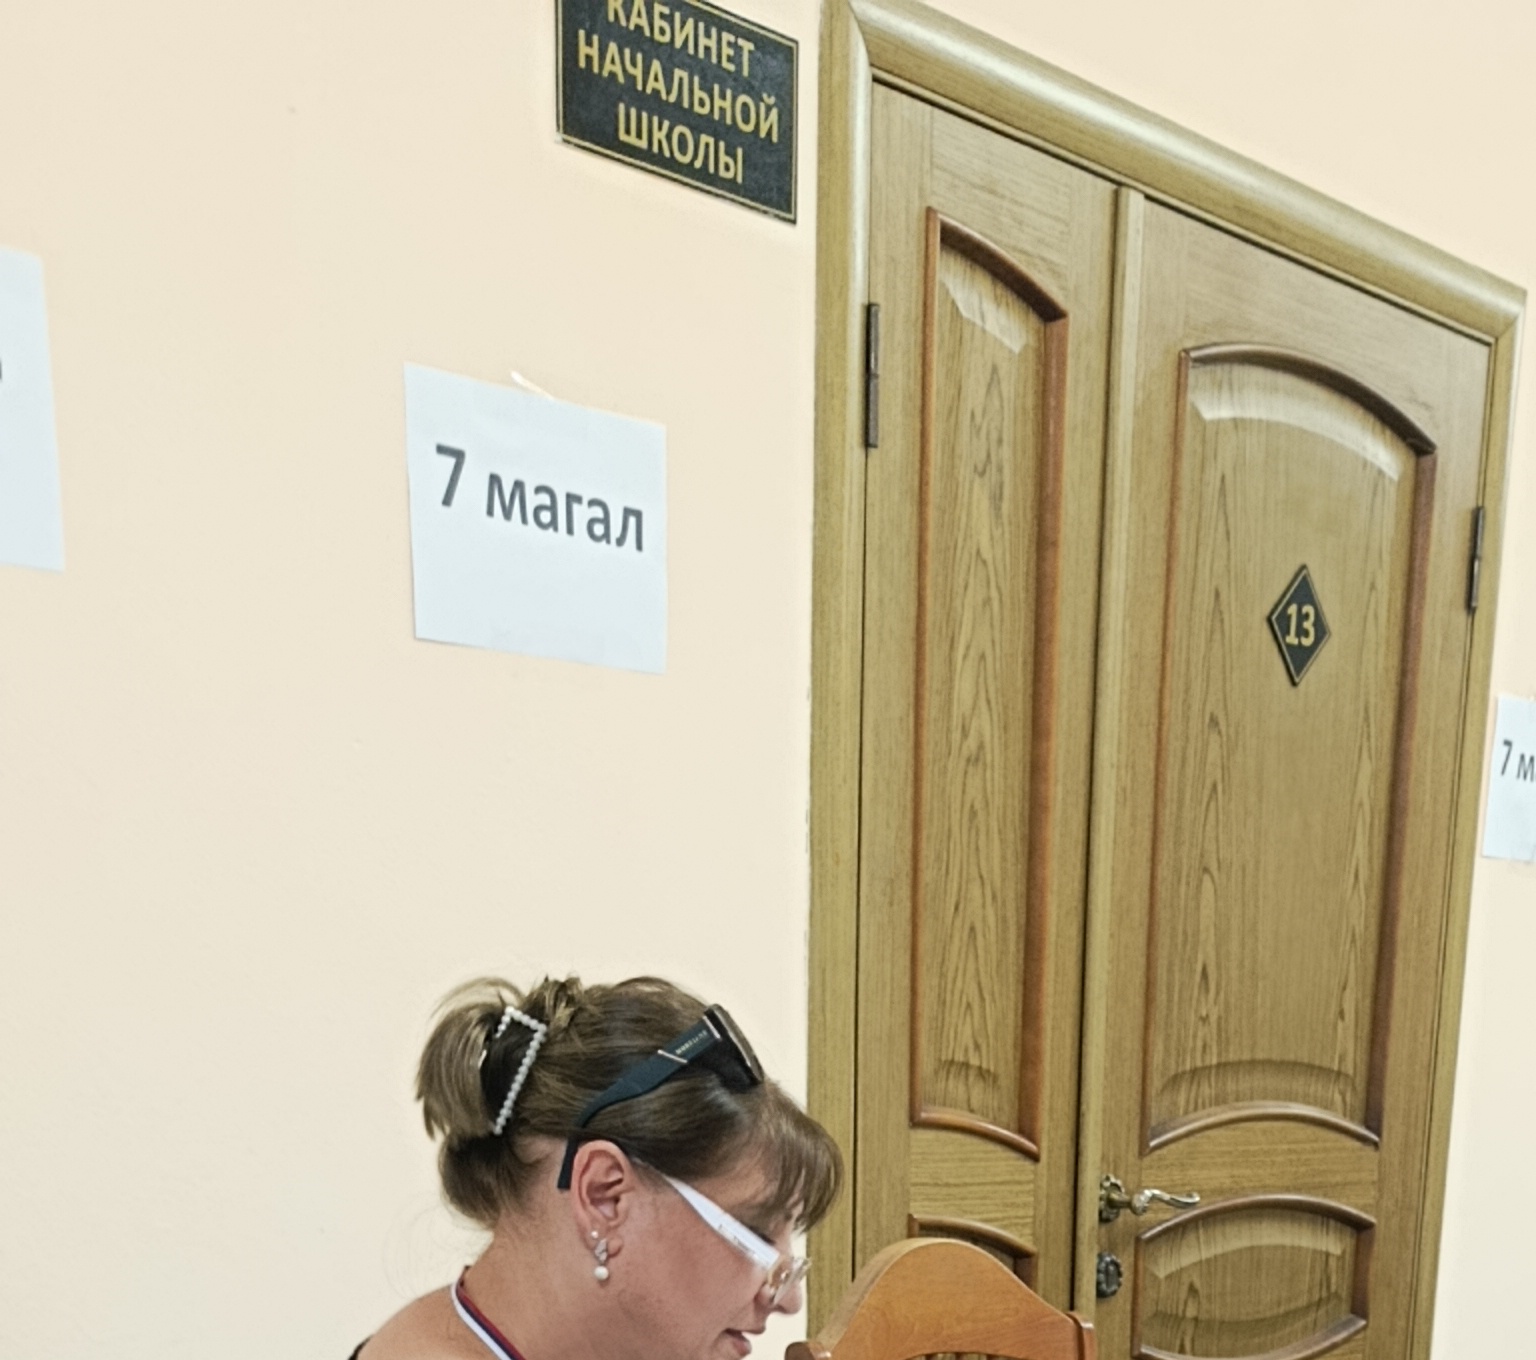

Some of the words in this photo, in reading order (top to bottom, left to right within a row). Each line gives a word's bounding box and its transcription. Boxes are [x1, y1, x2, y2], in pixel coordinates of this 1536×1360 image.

[607, 0, 755, 77] КАБИНЕТ
[578, 28, 779, 143] НАЧАЛЬНОЙ
[617, 102, 743, 184] ШКОЛЫ
[436, 442, 466, 508] 7
[486, 472, 644, 552] магал
[1285, 603, 1316, 647] 13
[1500, 738, 1513, 777] 7
